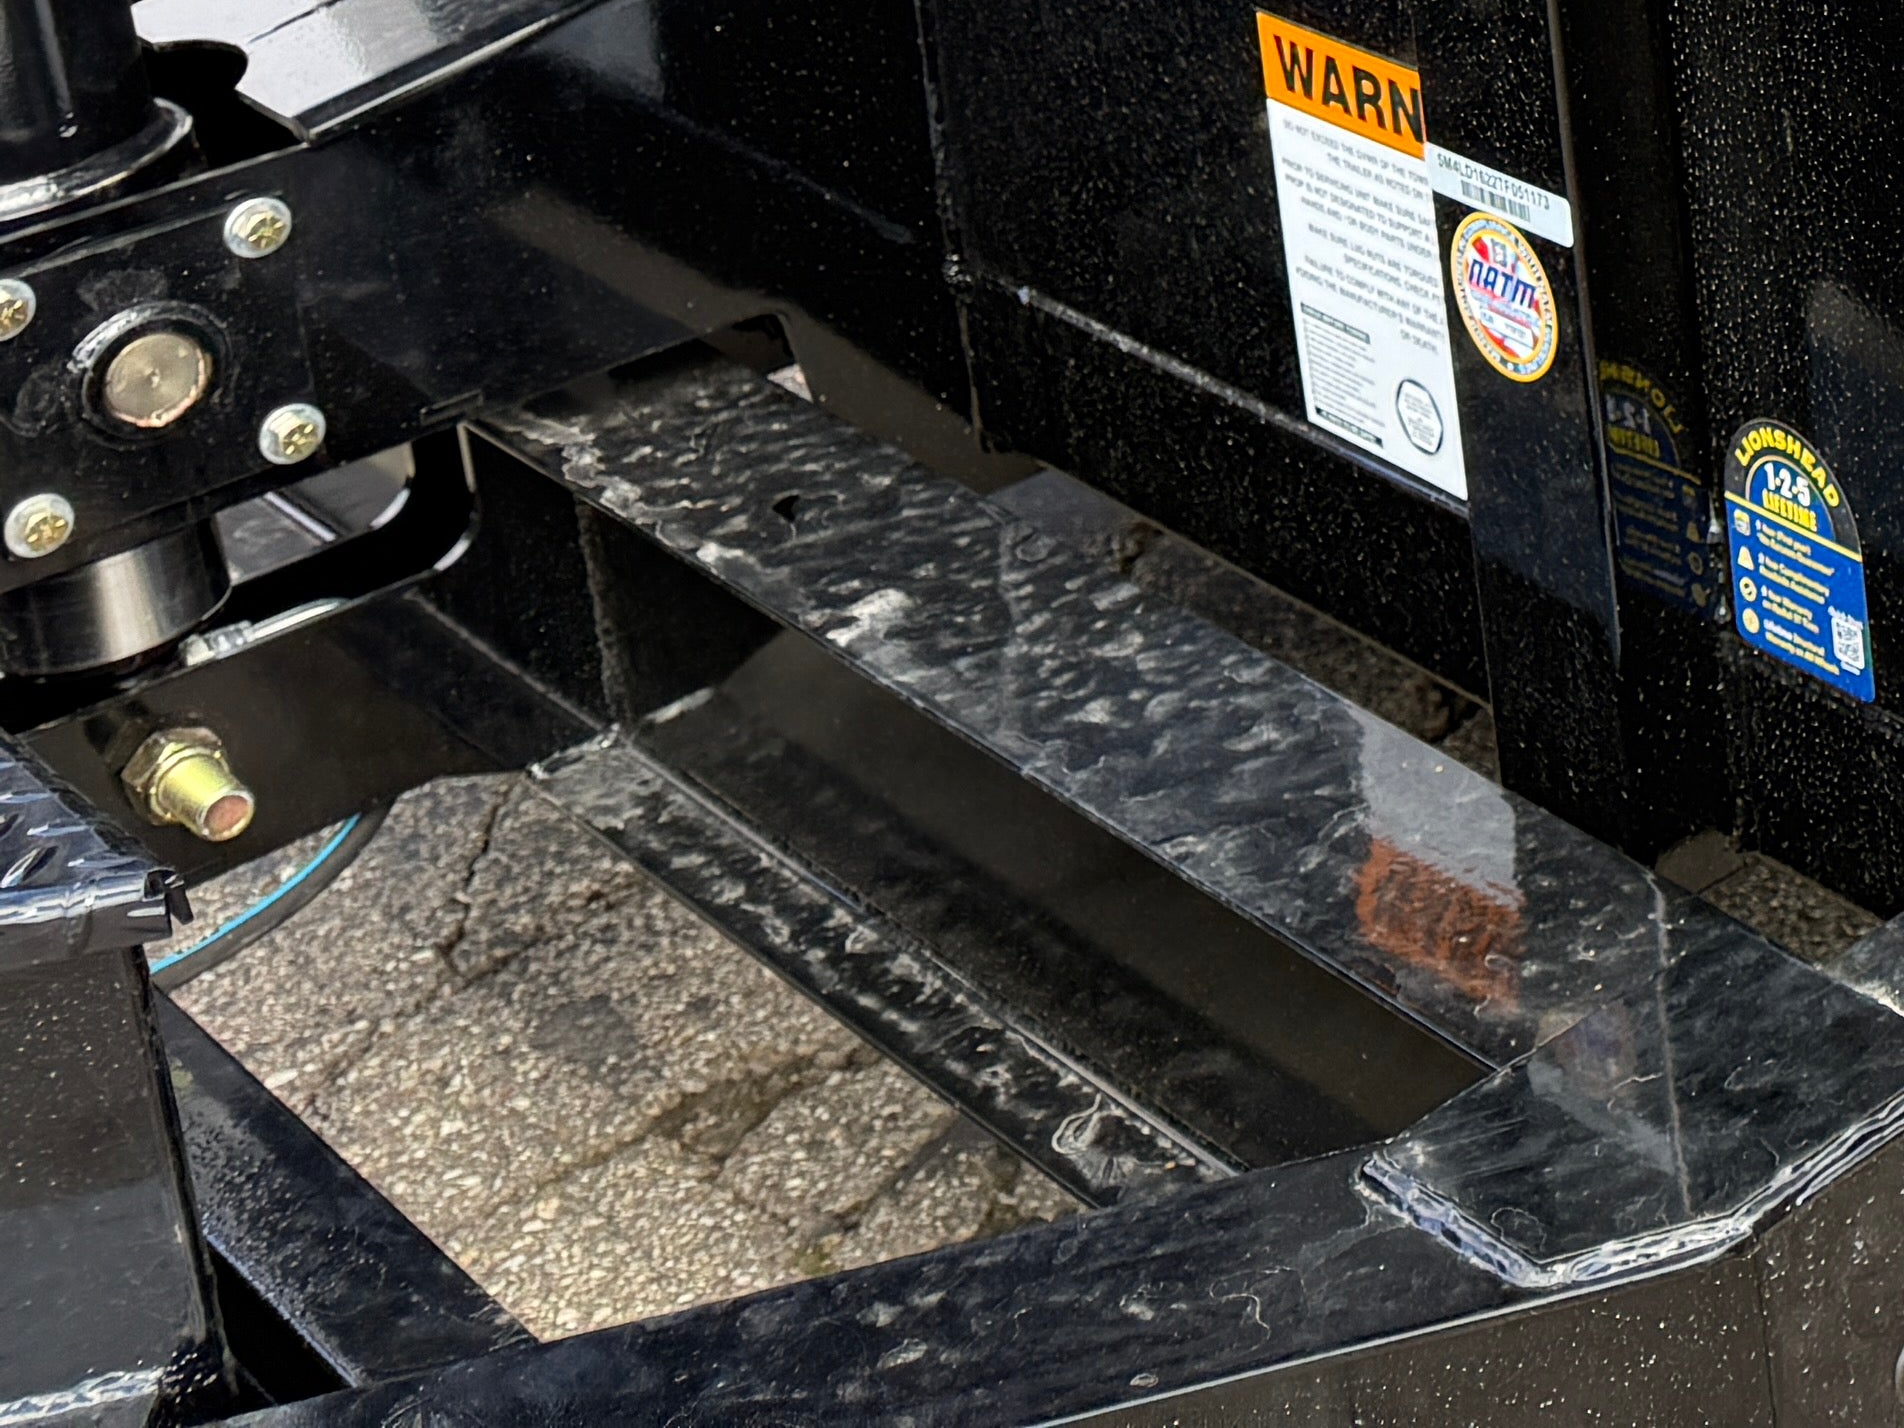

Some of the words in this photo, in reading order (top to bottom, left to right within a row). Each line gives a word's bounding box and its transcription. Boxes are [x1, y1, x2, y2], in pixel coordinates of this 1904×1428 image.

[1273, 34, 1425, 145] WARN
[1734, 426, 1840, 508] LIONSHEAD
[1762, 488, 1818, 532] LIFETIME
